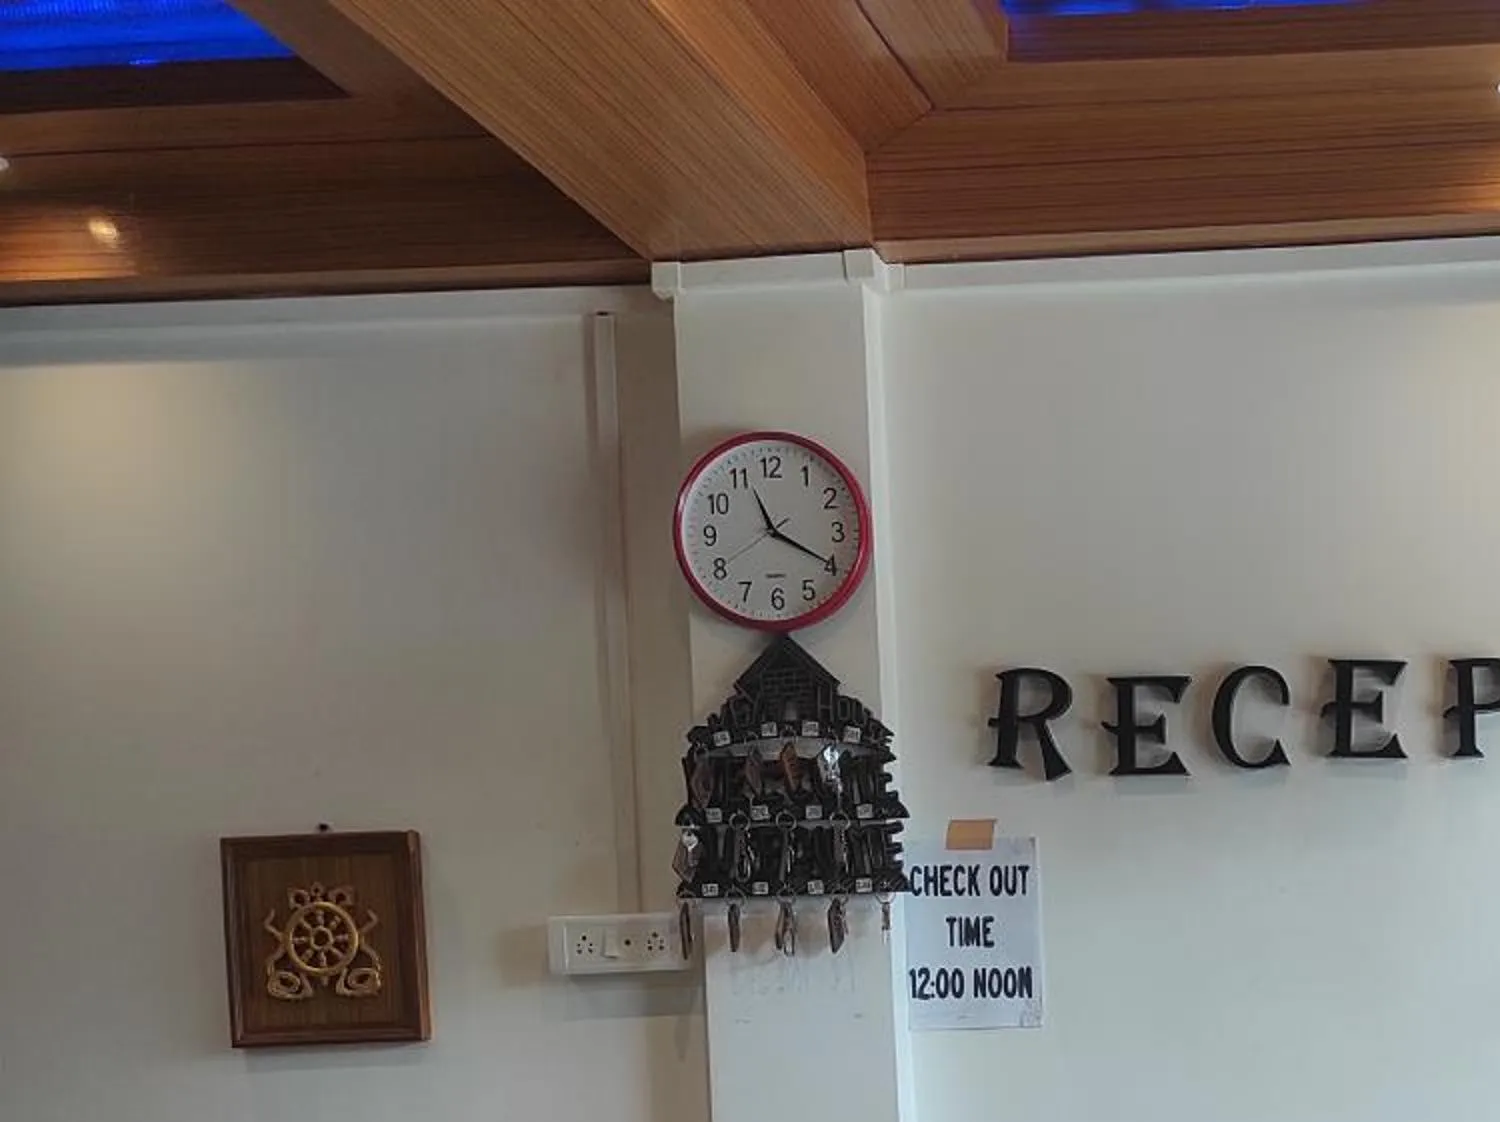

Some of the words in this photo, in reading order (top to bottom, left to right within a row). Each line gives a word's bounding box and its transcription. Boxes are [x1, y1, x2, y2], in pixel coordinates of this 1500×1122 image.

[760, 456, 782, 478] 12
[801, 466, 809, 487] 1
[730, 468, 748, 489] 11
[708, 493, 729, 514] 10
[823, 488, 838, 510] 2
[703, 525, 717, 546] 9
[831, 521, 845, 543] 3
[713, 557, 728, 580] 8
[824, 555, 837, 576] 4
[738, 581, 752, 602] 7
[770, 587, 785, 610] 6
[802, 579, 816, 601] 5
[909, 864, 981, 897] CHECK
[989, 865, 1030, 897] OUT
[946, 915, 995, 949] TIME
[908, 966, 965, 1000] 12:00
[973, 965, 1033, 999] NOON
